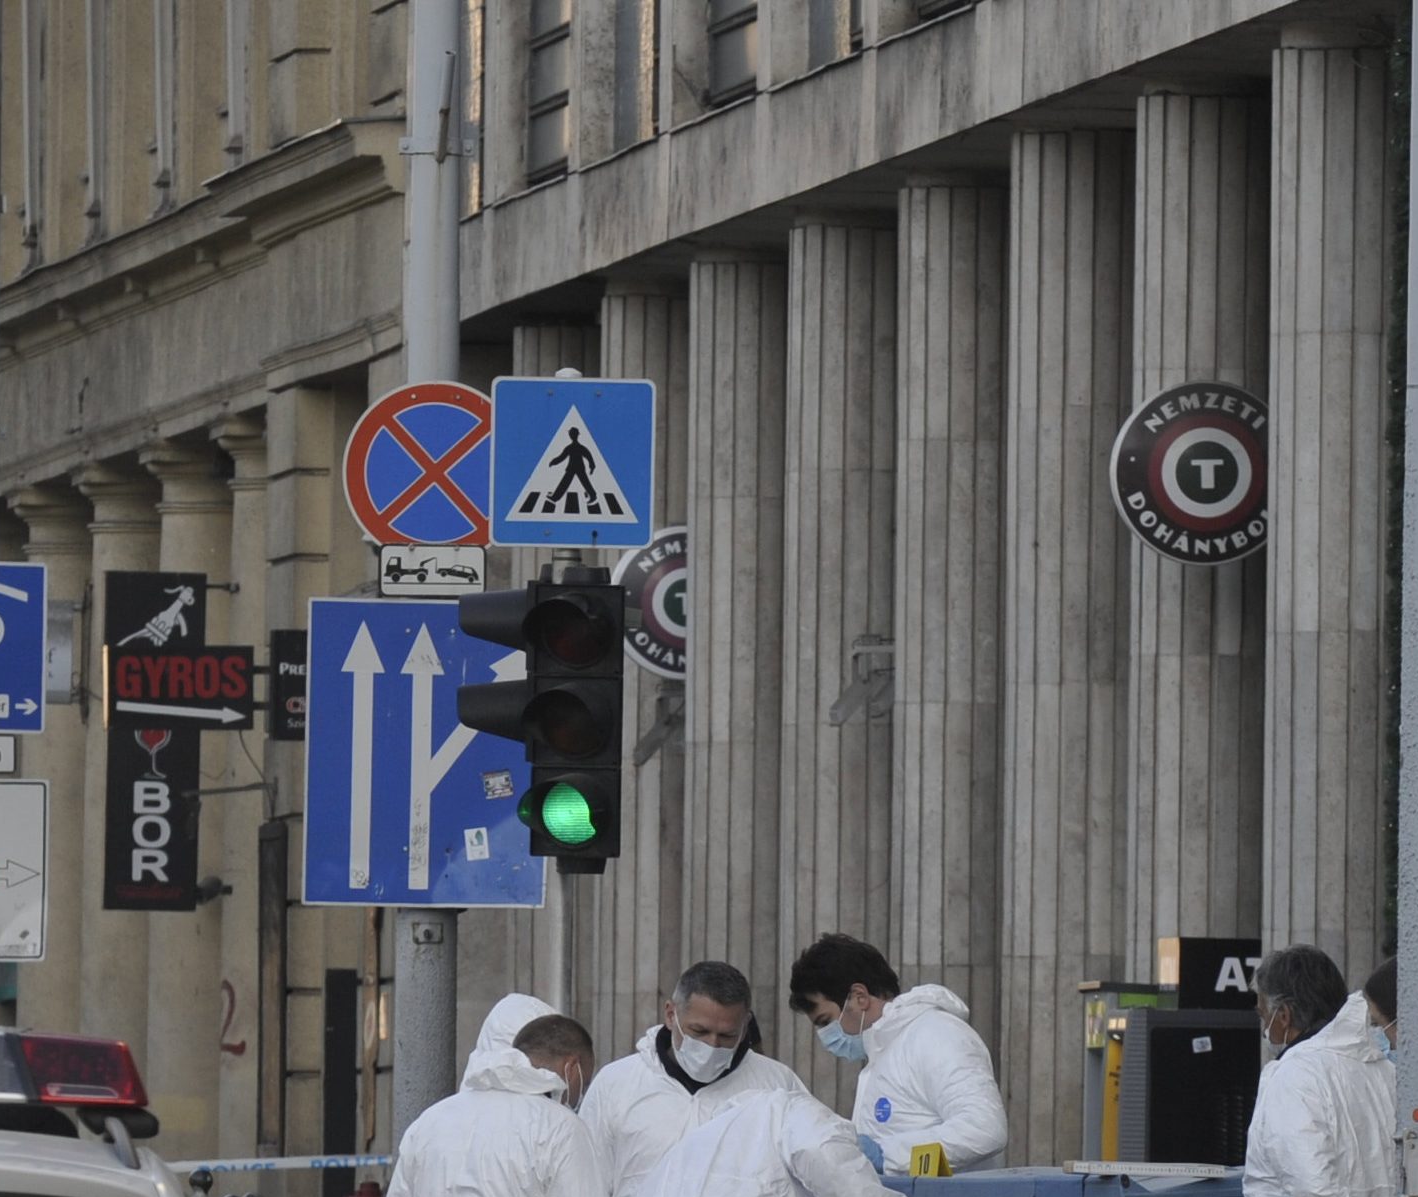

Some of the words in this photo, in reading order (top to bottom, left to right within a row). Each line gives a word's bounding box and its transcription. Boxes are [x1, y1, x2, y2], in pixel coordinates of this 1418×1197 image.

[1144, 392, 1268, 433] NEMZETI
[1191, 458, 1224, 489] T
[1127, 491, 1268, 556] DOHÁNYBO
[638, 540, 688, 573] NEM
[116, 654, 247, 699] GYROS
[279, 662, 307, 675] PRE
[133, 781, 171, 883] BOR
[918, 1153, 930, 1175] 10
